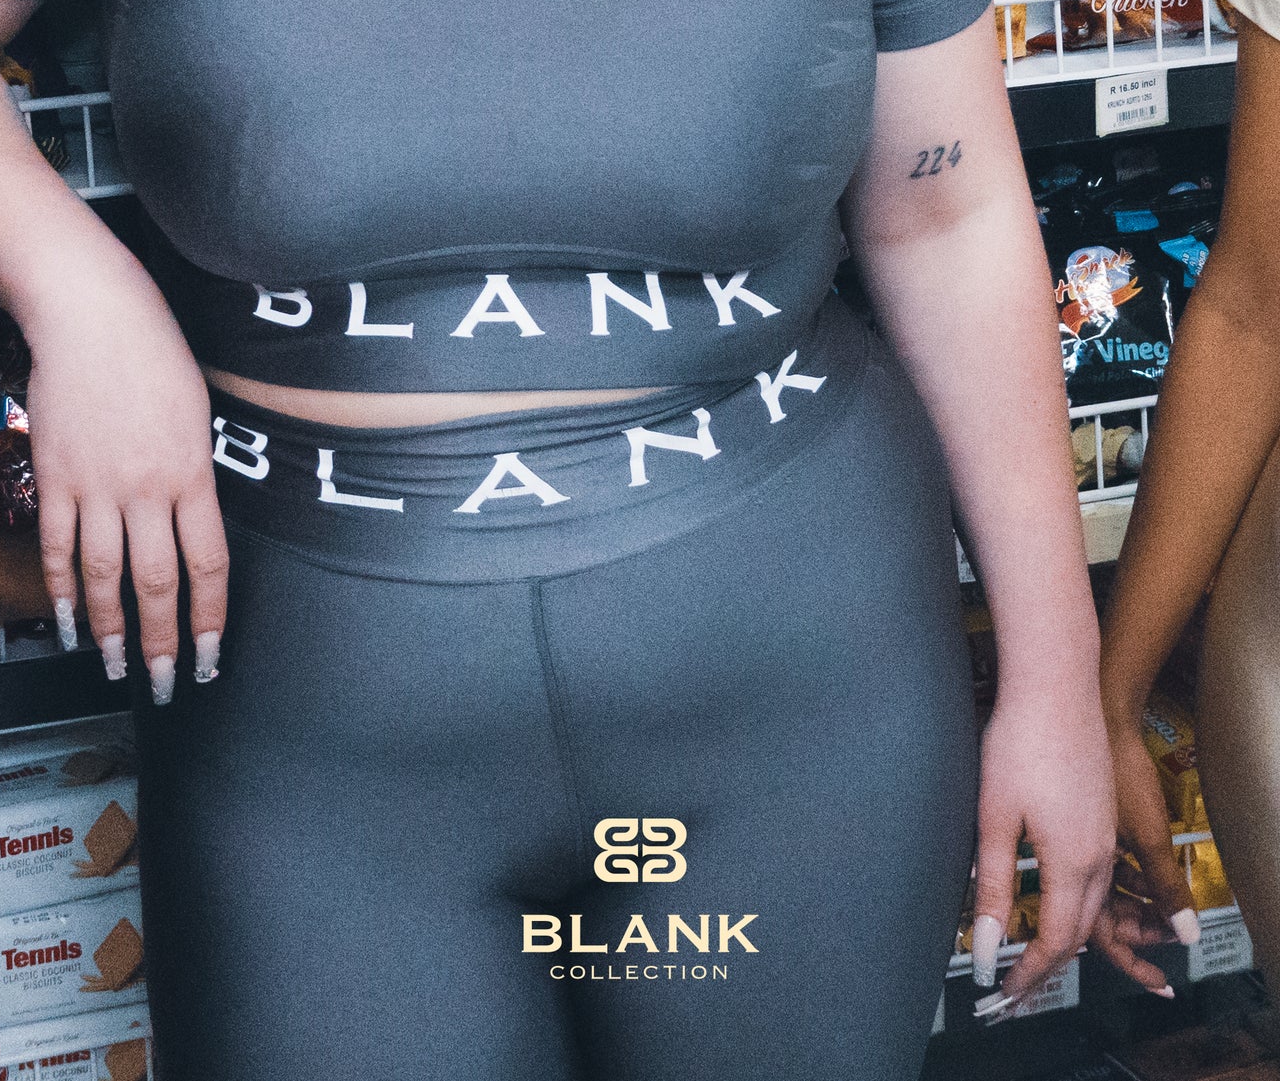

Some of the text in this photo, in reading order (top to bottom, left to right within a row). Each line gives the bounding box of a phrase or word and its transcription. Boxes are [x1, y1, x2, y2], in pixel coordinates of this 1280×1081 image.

[1110, 78, 1156, 95] R 16.50 incl
[251, 270, 782, 339] BLANK
[1094, 336, 1169, 366] Vineg
[213, 350, 827, 514] BLANK
[33, 848, 73, 865] COCONUT
[1, 939, 83, 971] Tennis
[2, 962, 82, 985] CLASSIC COCONUT
